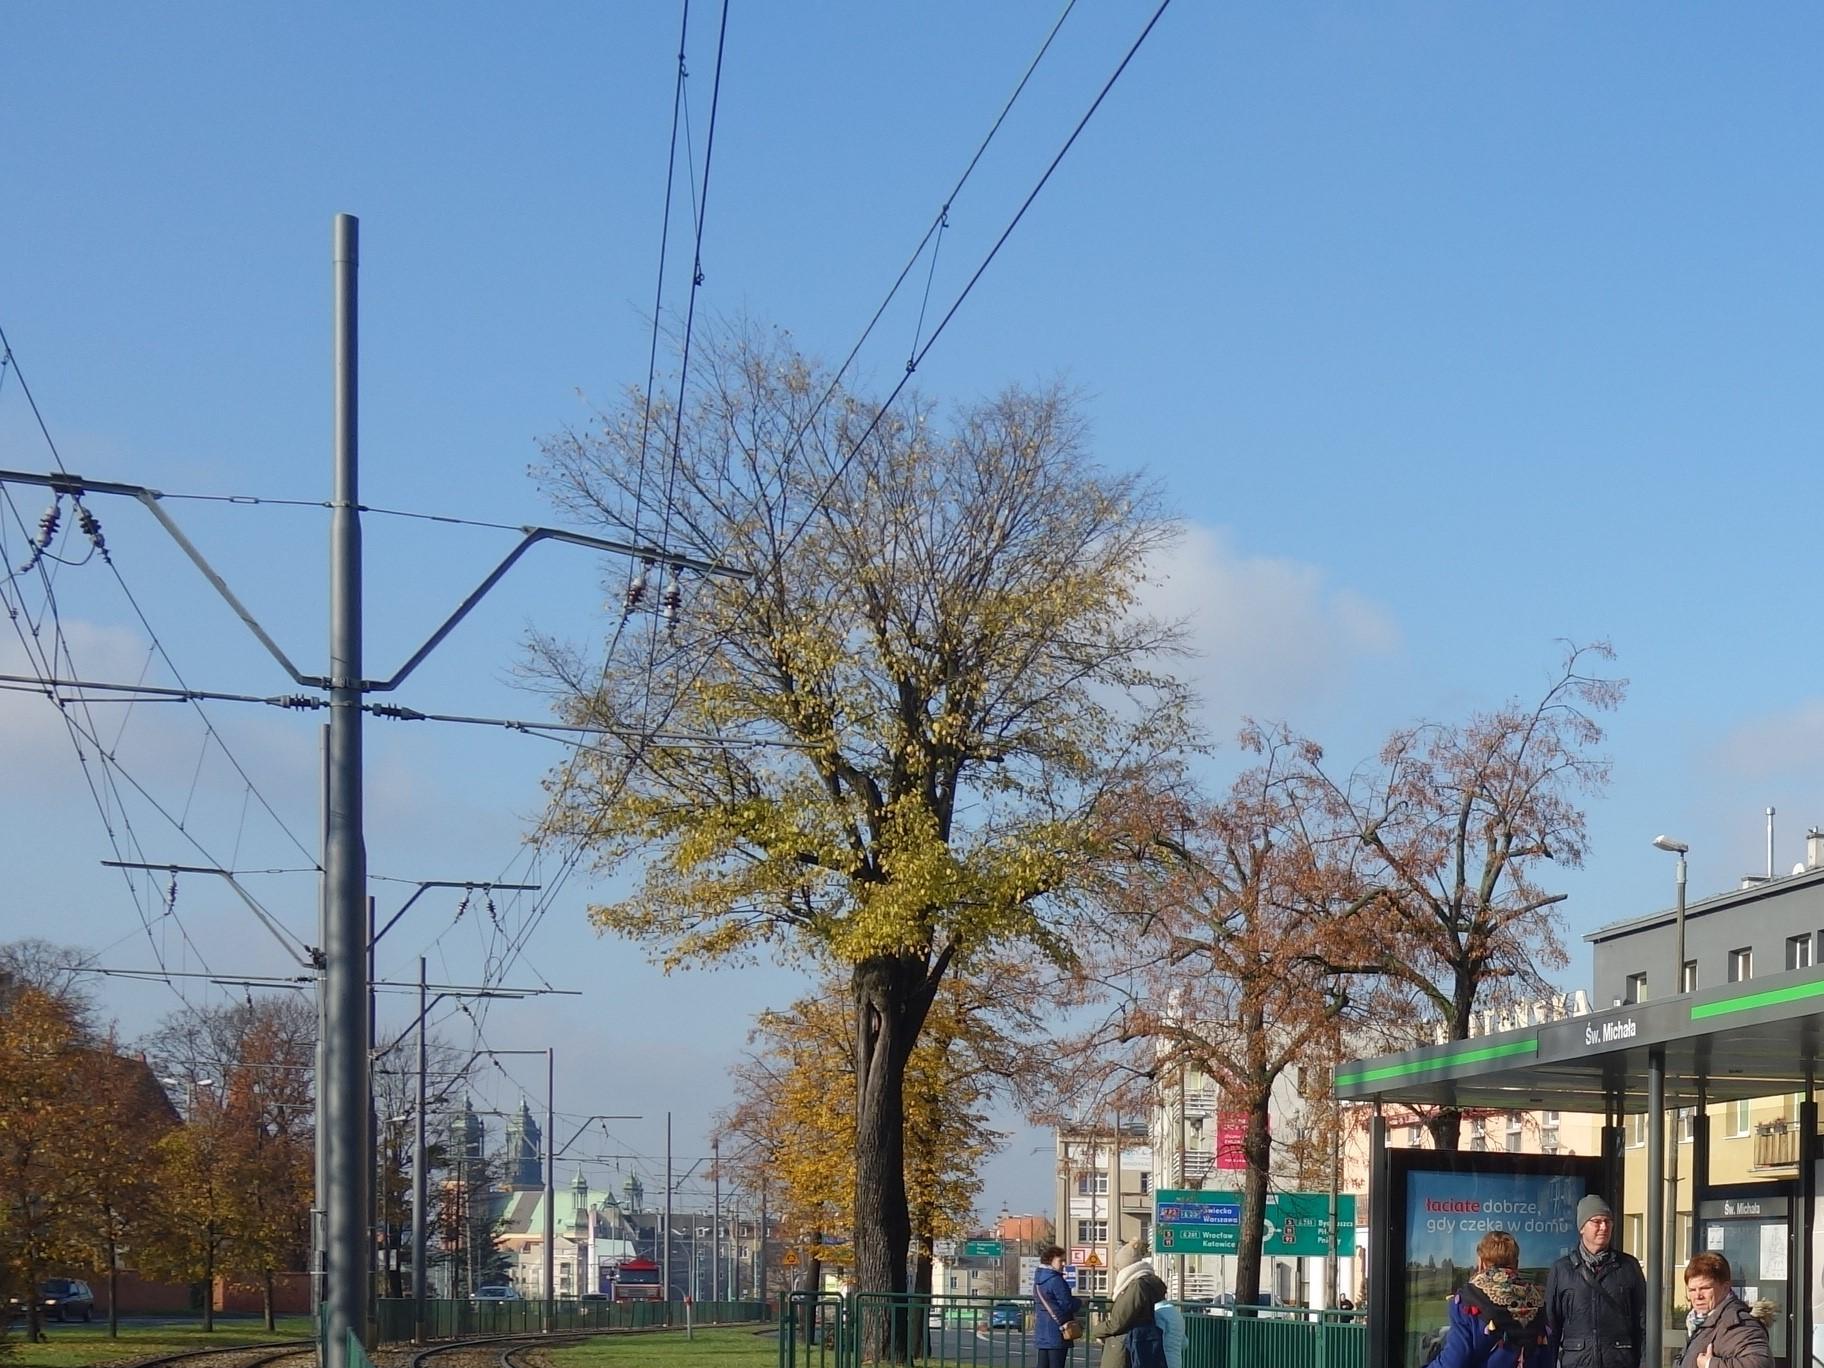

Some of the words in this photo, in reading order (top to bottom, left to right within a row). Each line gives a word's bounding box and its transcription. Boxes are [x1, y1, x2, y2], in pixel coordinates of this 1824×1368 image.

[1585, 1021, 1600, 1046] Św.
[1602, 1018, 1636, 1042] Michała
[1425, 1197, 1480, 1214] łaciate
[1483, 1199, 1542, 1216] dobrze,
[1723, 1200, 1736, 1216] Św.
[1736, 1202, 1761, 1215] Michała
[1203, 1215, 1238, 1224] Warszawa
[1426, 1216, 1456, 1234] gdy
[1459, 1217, 1503, 1232] czeka
[1507, 1221, 1521, 1232] w
[1202, 1231, 1234, 1240] Wrocław
[1202, 1240, 1236, 1249] Katowice
